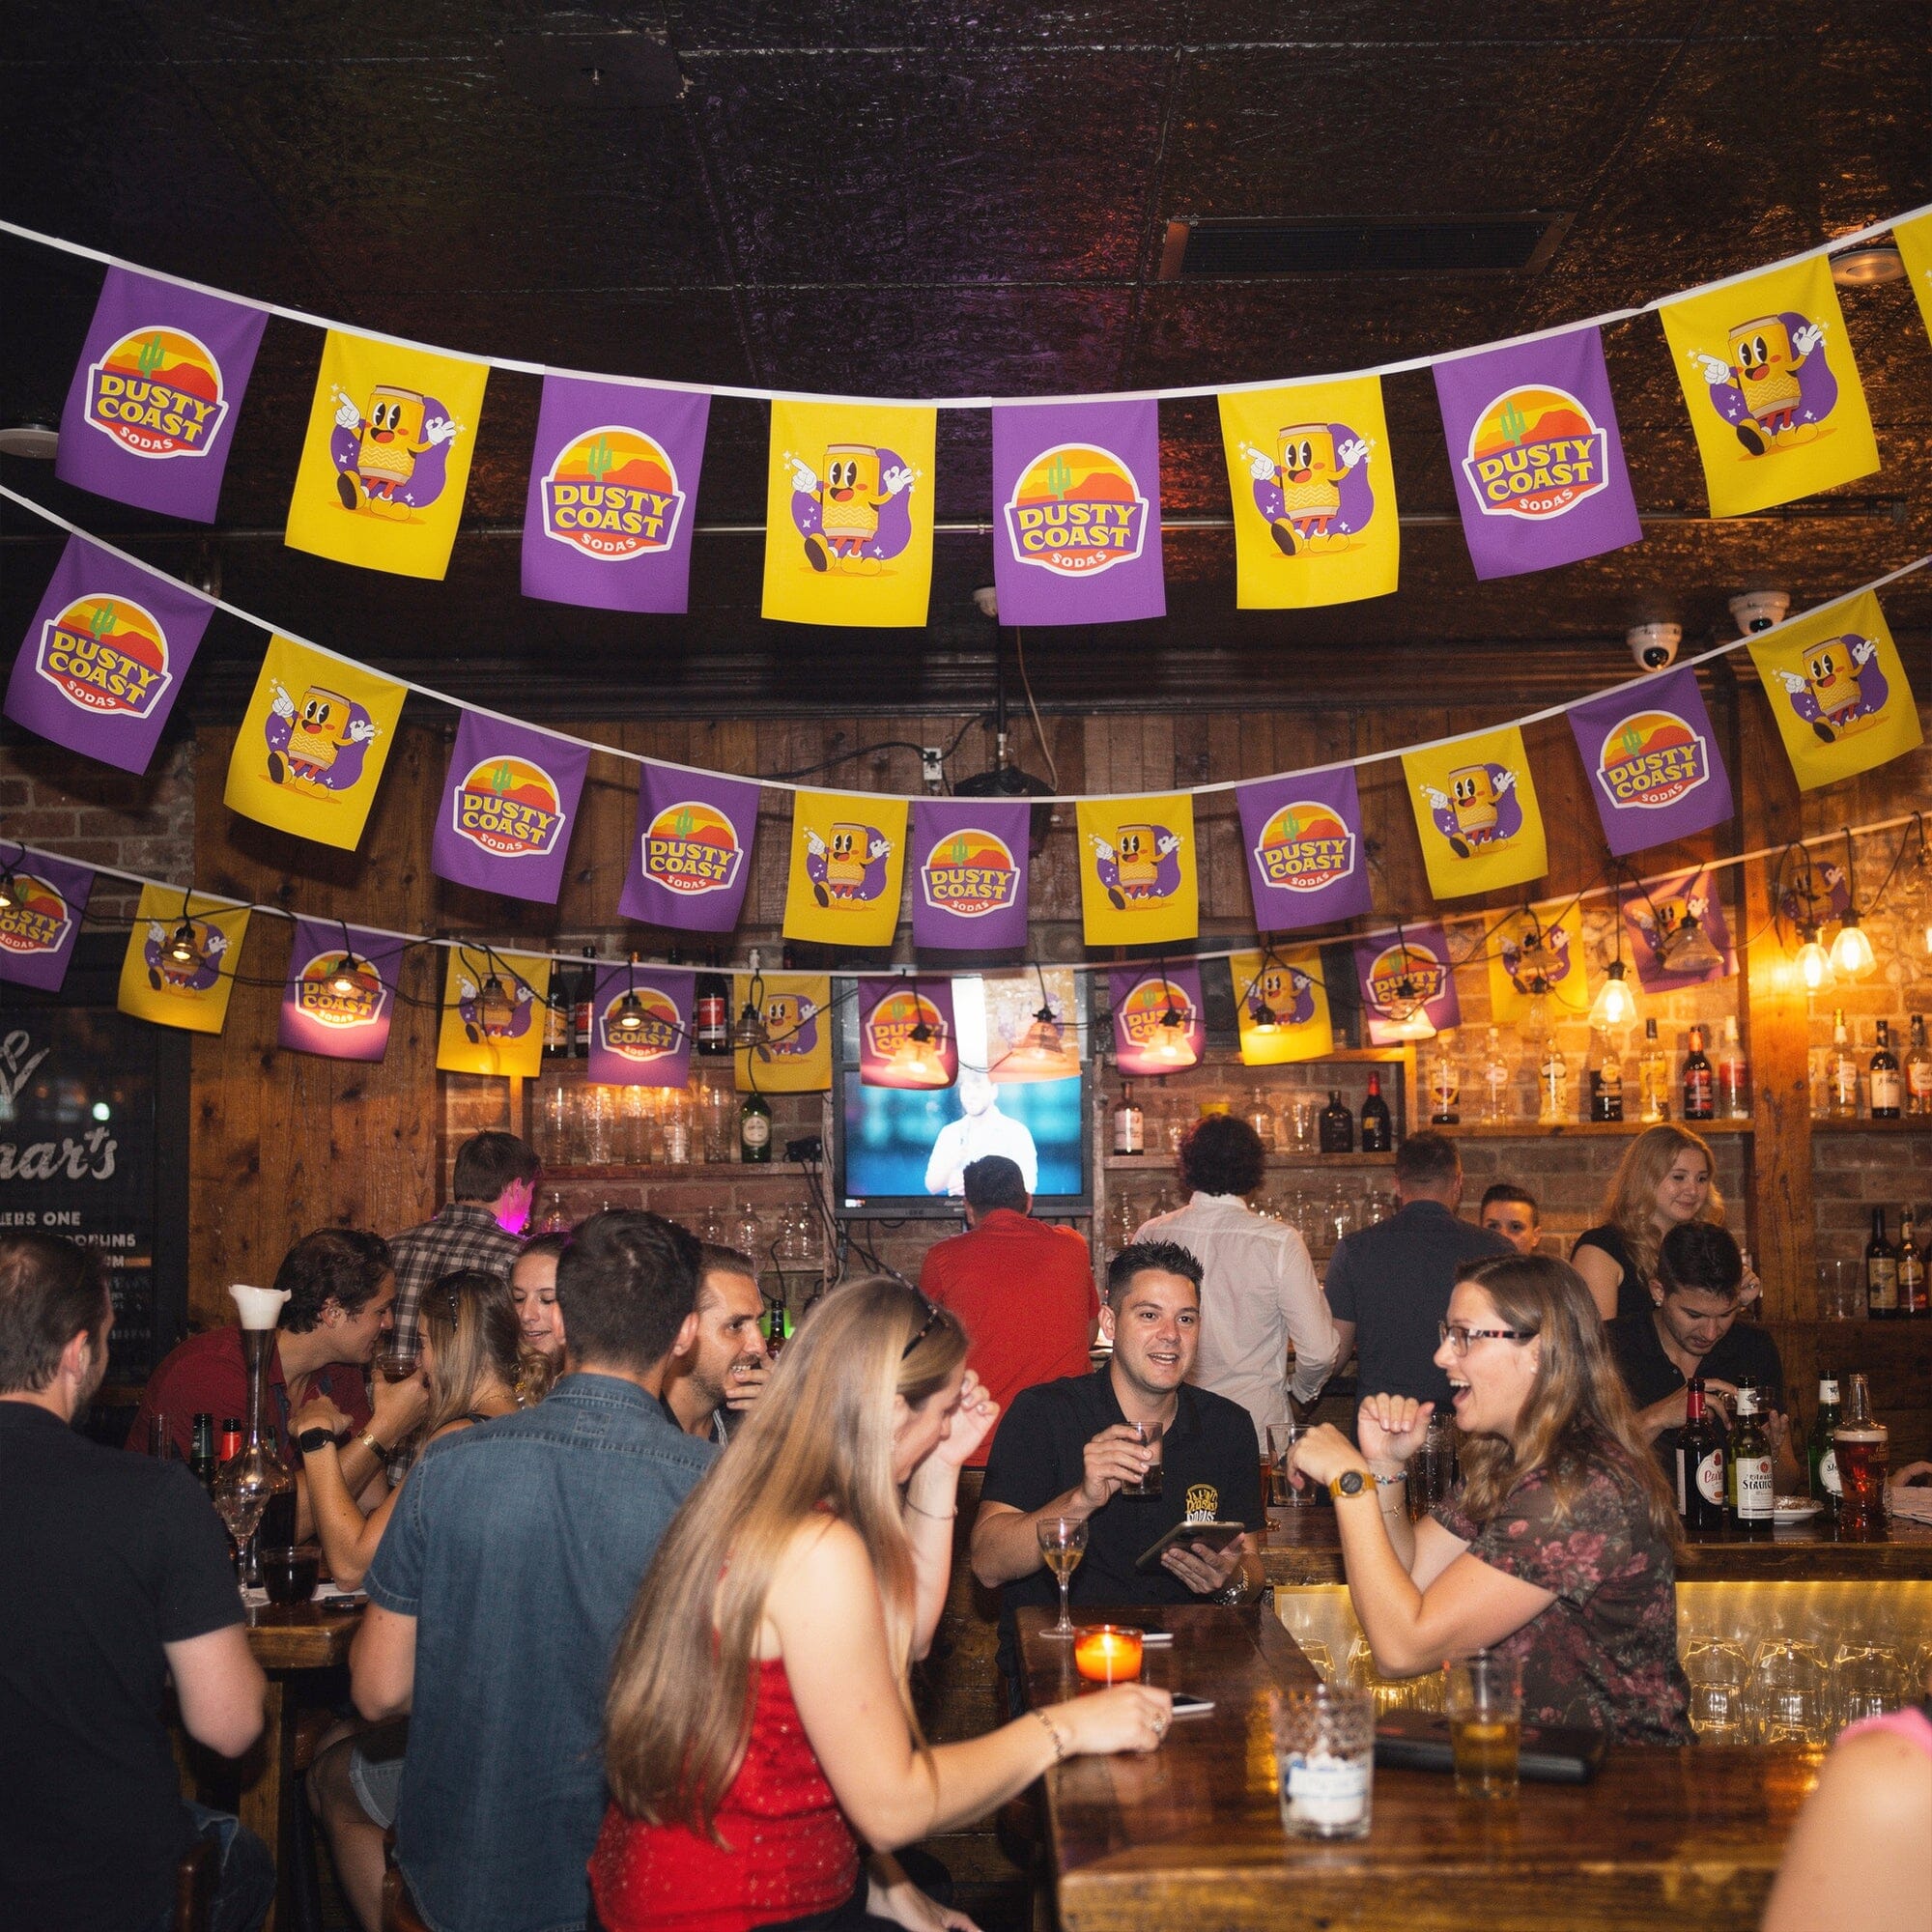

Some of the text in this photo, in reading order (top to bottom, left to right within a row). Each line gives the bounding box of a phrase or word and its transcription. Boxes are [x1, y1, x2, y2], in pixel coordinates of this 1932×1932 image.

[99, 374, 215, 422] DUSTY
[97, 397, 203, 443] COAST
[119, 426, 174, 449] SODAS
[1476, 438, 1595, 482] DUSTY
[1487, 461, 1594, 501] COAST
[554, 485, 672, 516] DUSTY
[1519, 489, 1574, 511] SODAS
[554, 507, 665, 538] COAST
[1017, 503, 1138, 530] DUSTY
[581, 532, 637, 552] SODAS
[1022, 526, 1131, 551] COAST
[1051, 551, 1107, 568] SODAS
[52, 631, 160, 689] DUSTY
[48, 652, 146, 704] COAST
[67, 679, 117, 707] SODAS
[1607, 745, 1697, 785] DUSTY
[1616, 760, 1697, 798] COAST
[1641, 782, 1684, 803] SODAS
[464, 794, 555, 828] DUSTY
[463, 811, 546, 844] COAST
[480, 834, 524, 850] SODAS
[650, 840, 734, 865] DUSTY
[1264, 838, 1348, 866] DUSTY
[650, 857, 726, 880] COAST
[930, 869, 1012, 885] DUSTY
[1269, 854, 1345, 879] COAST
[1291, 871, 1330, 887] SODAS
[667, 875, 707, 889] SODAS
[932, 884, 1007, 900] COAST
[952, 899, 989, 912] SODAS
[0, 909, 63, 932] USTY
[0, 919, 54, 944] OAST
[303, 995, 373, 1015] COAST
[609, 1031, 672, 1048] COAST
[43, 1211, 81, 1226] ONE
